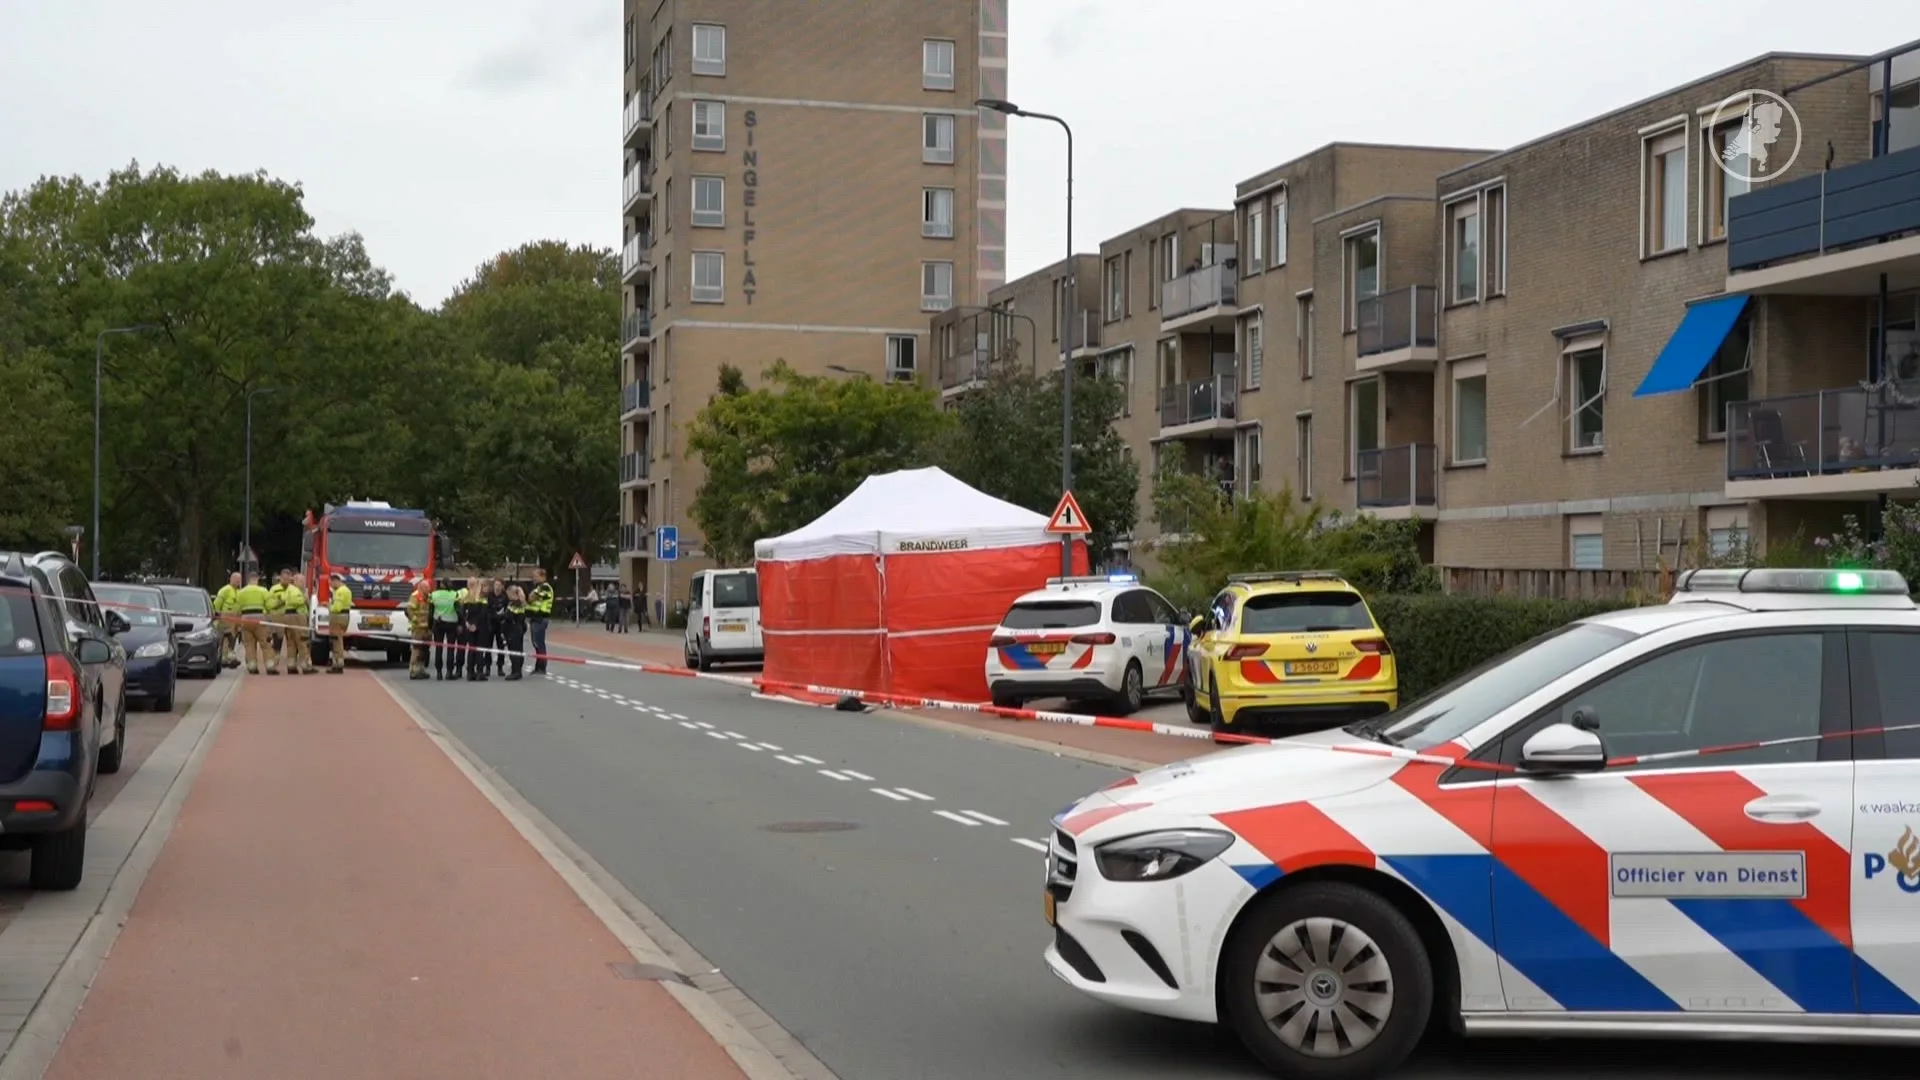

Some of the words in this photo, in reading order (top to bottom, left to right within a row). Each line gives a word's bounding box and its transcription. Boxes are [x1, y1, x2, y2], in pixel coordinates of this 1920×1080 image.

[743, 110, 757, 305] SINGELFLAT
[900, 539, 968, 551] BRANDWEER
[350, 567, 405, 575] BRANDWEER
[1617, 867, 1685, 883] Officier
[1695, 870, 1728, 883] van
[1738, 867, 1798, 883] Dienst
